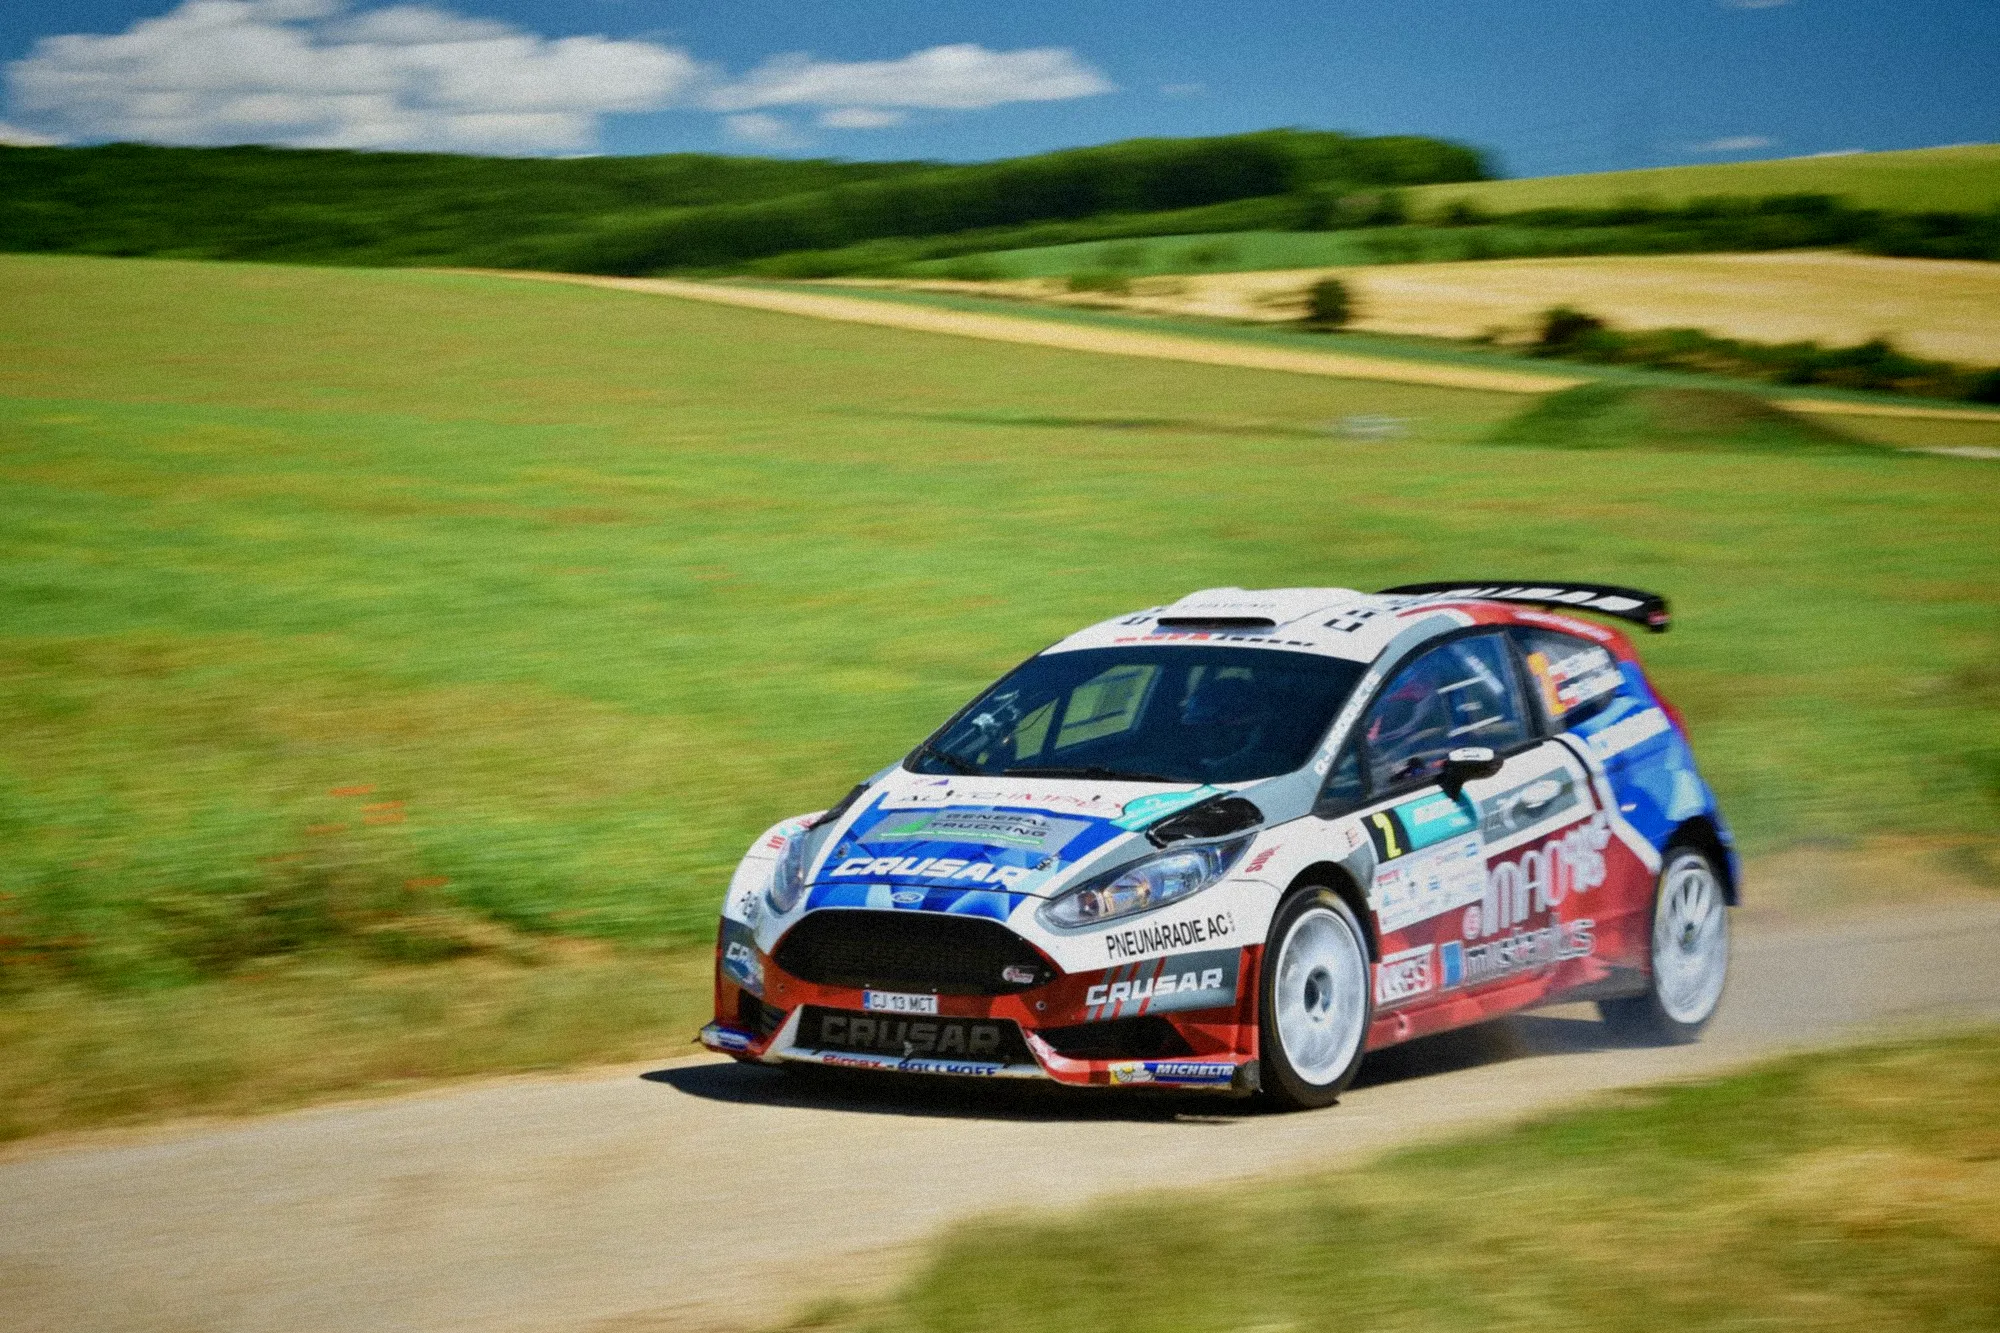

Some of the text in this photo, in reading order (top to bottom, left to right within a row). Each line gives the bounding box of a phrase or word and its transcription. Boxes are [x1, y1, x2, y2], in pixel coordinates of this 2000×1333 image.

[931, 821, 1049, 838] TRUCKING
[945, 812, 1051, 827] GENERAL
[1371, 812, 1402, 859] 2
[829, 856, 1031, 884] CRUSAR
[1208, 914, 1230, 940] AC
[1085, 968, 1223, 1006] CRUSAR
[820, 1015, 1000, 1053] CRUSAR
